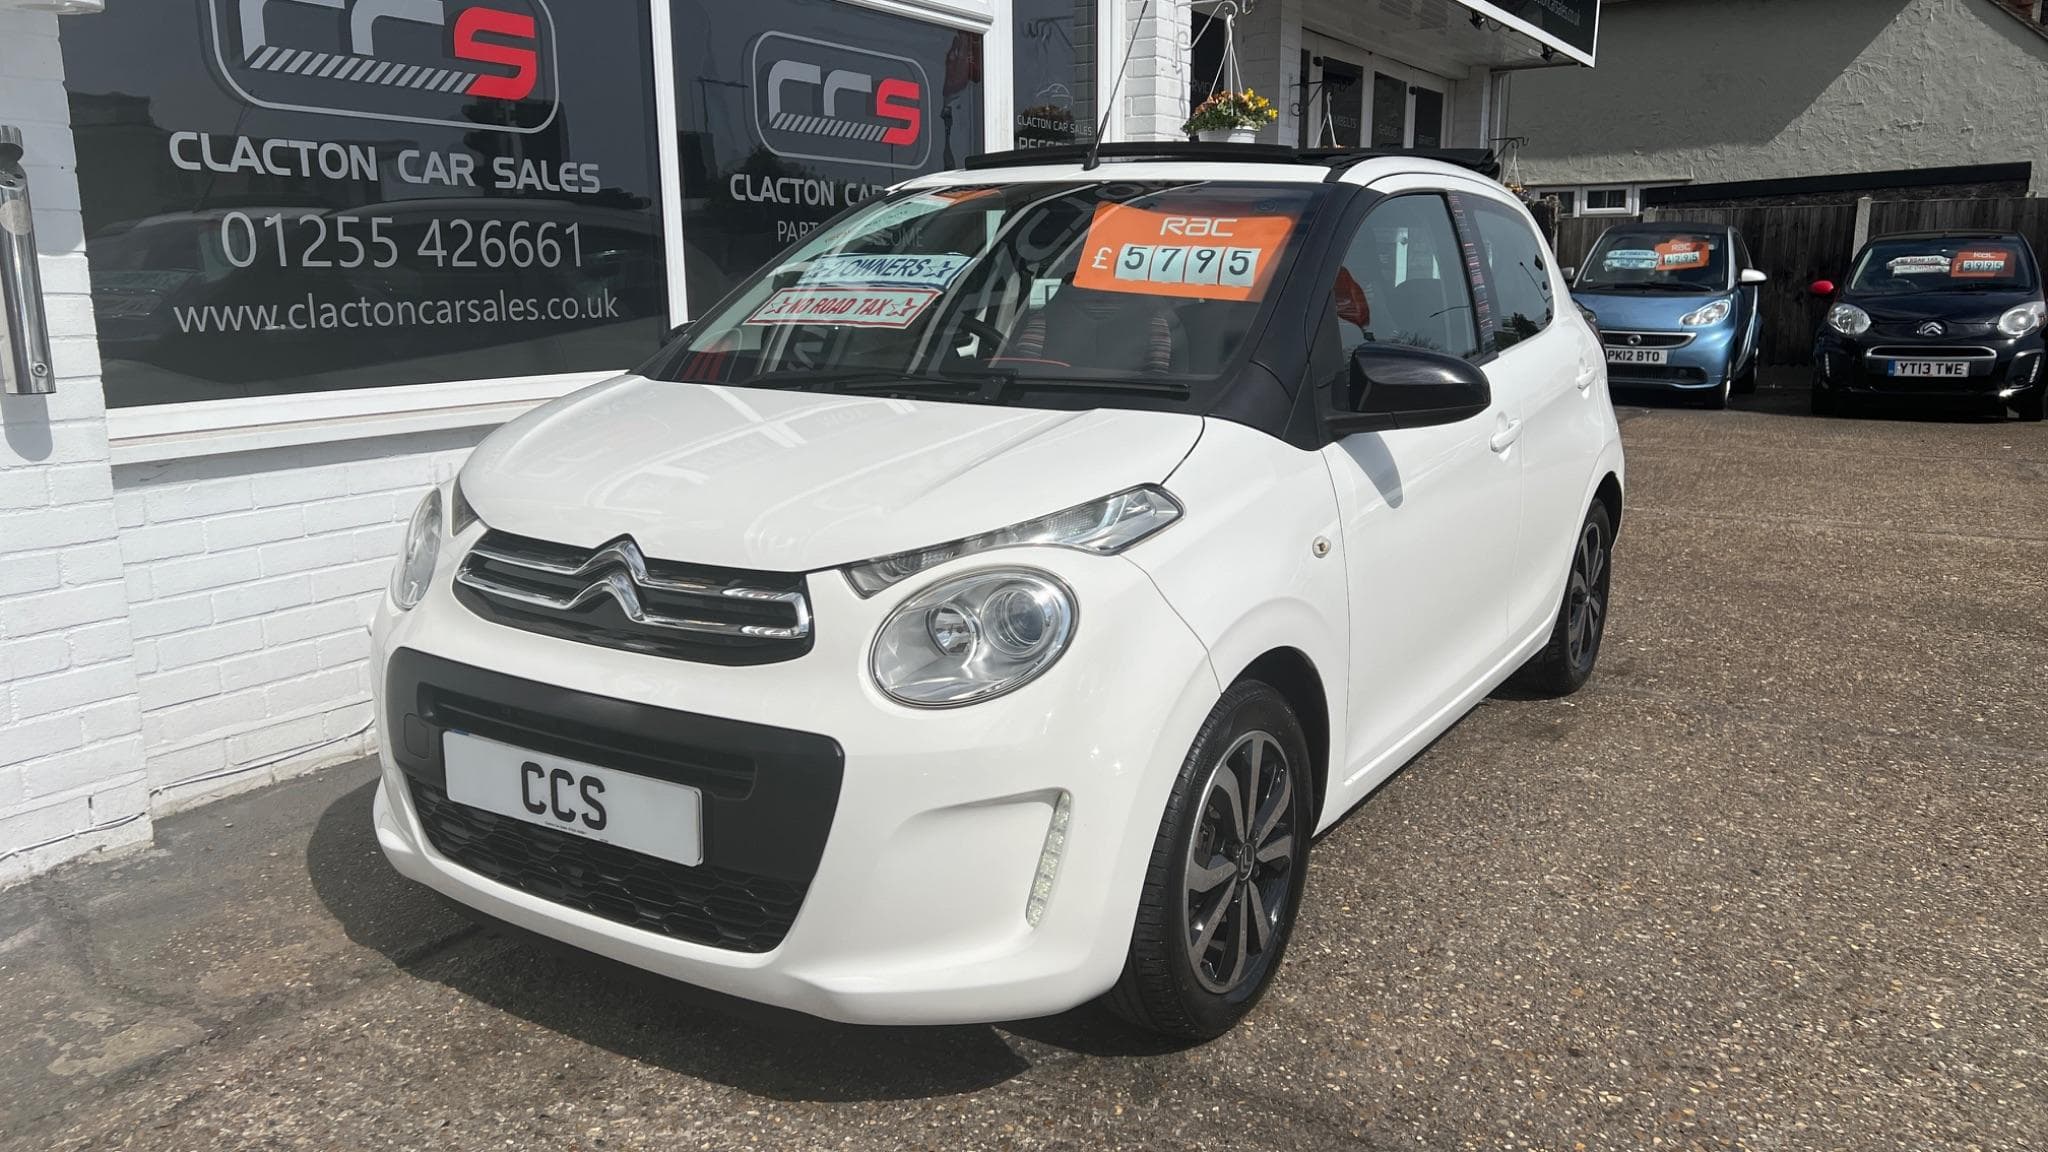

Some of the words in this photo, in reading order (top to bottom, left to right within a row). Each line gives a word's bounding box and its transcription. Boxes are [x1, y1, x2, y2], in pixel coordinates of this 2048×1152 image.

[1016, 115, 1051, 129] CLACTON
[1053, 120, 1068, 132] CAR
[1070, 123, 1092, 136] SALES
[169, 131, 379, 182] CLACTON
[397, 150, 476, 187] CAR
[493, 156, 601, 194] SALES
[730, 174, 835, 207] CLACTON
[221, 211, 398, 269] 01255
[417, 218, 582, 268] 426661
[840, 257, 930, 278] OWNERS
[173, 289, 620, 333] www.clactoncarsales.co.uk
[786, 298, 811, 314] NO
[809, 298, 856, 315] ROAD
[854, 298, 892, 316] TAX
[1607, 350, 1634, 361] PK12
[1636, 351, 1660, 362] BTO
[1900, 362, 1931, 375] YT13
[1936, 363, 1964, 375] TWE
[521, 761, 607, 831] CCS
